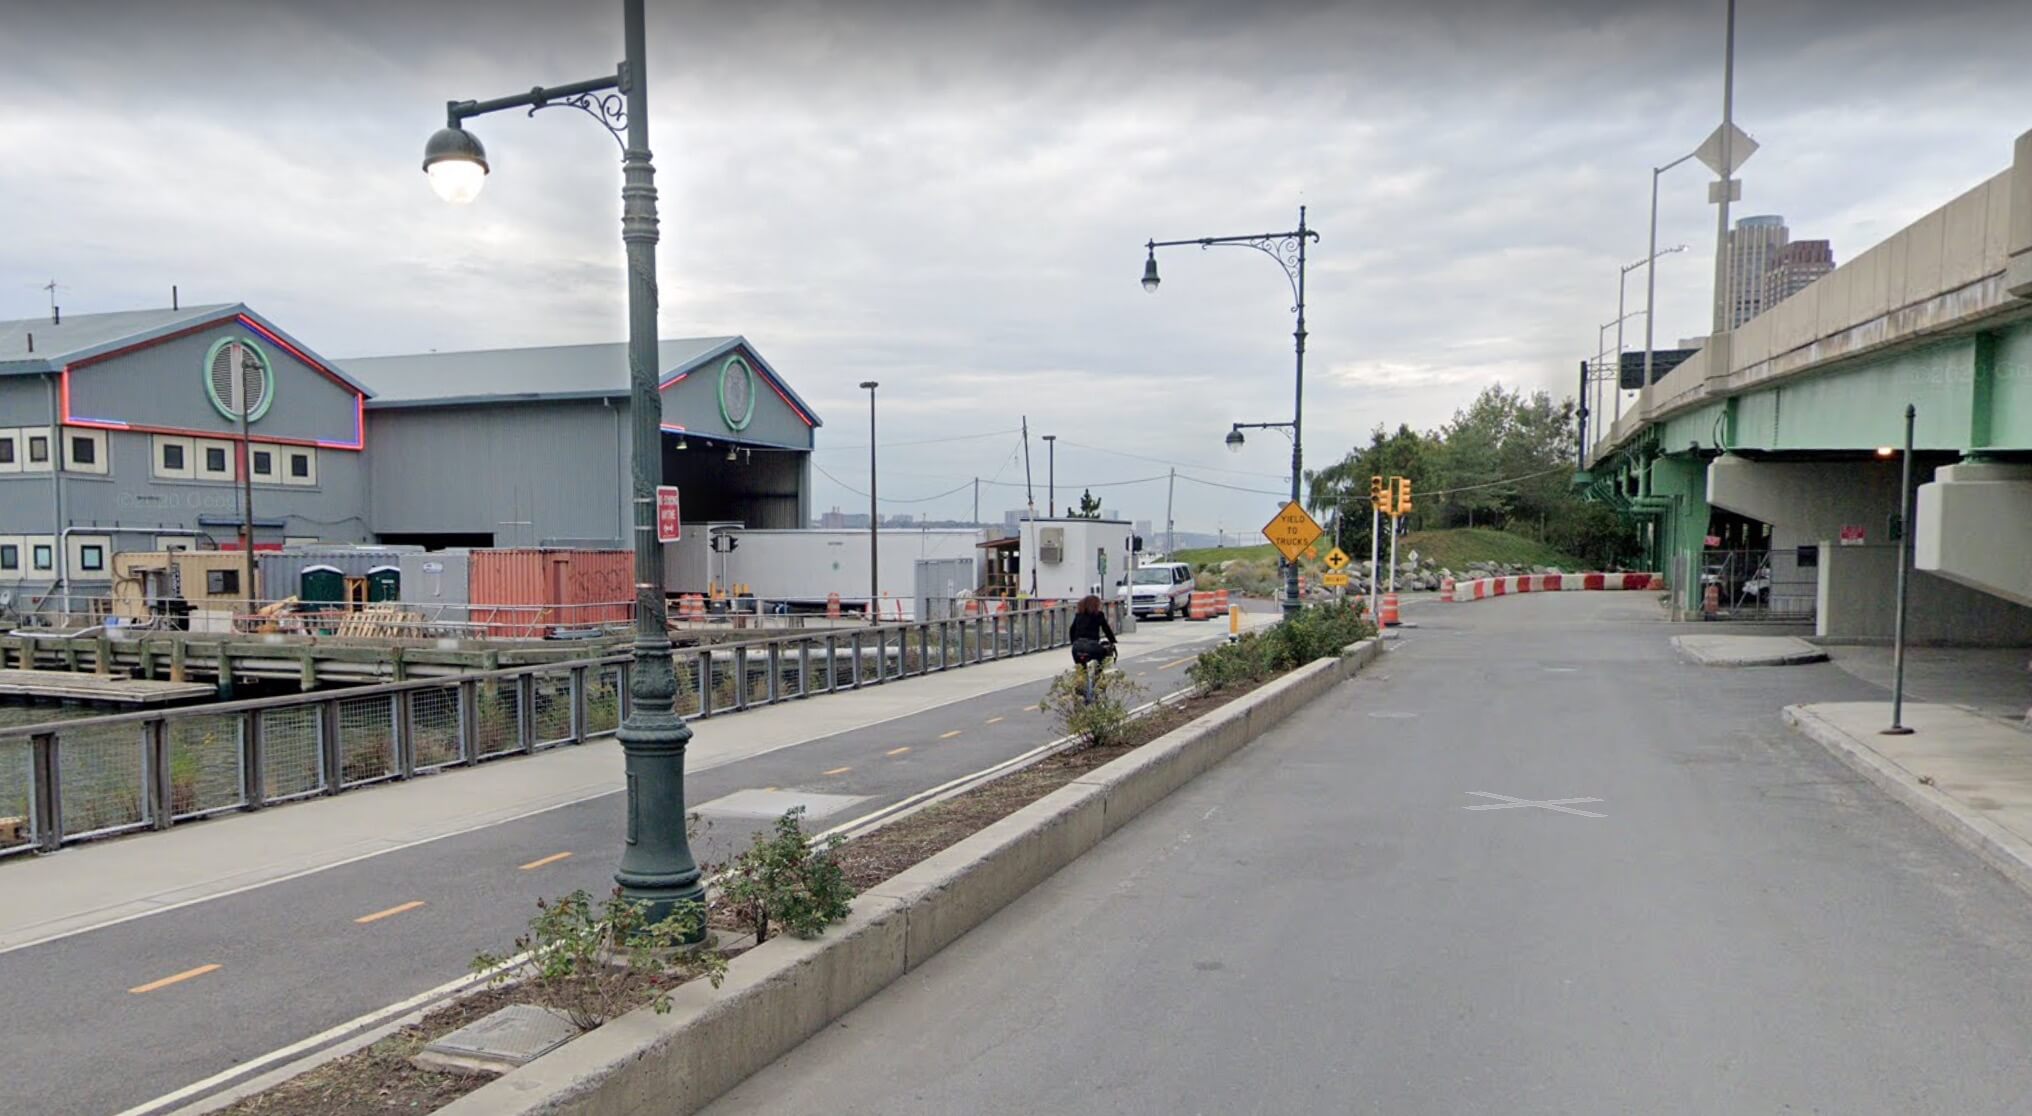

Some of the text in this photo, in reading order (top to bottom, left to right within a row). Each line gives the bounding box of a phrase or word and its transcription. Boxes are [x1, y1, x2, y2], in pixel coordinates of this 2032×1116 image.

[1281, 515, 1305, 523] YIELD
[1287, 526, 1298, 535] TO
[1276, 537, 1308, 545] TRUCKS
